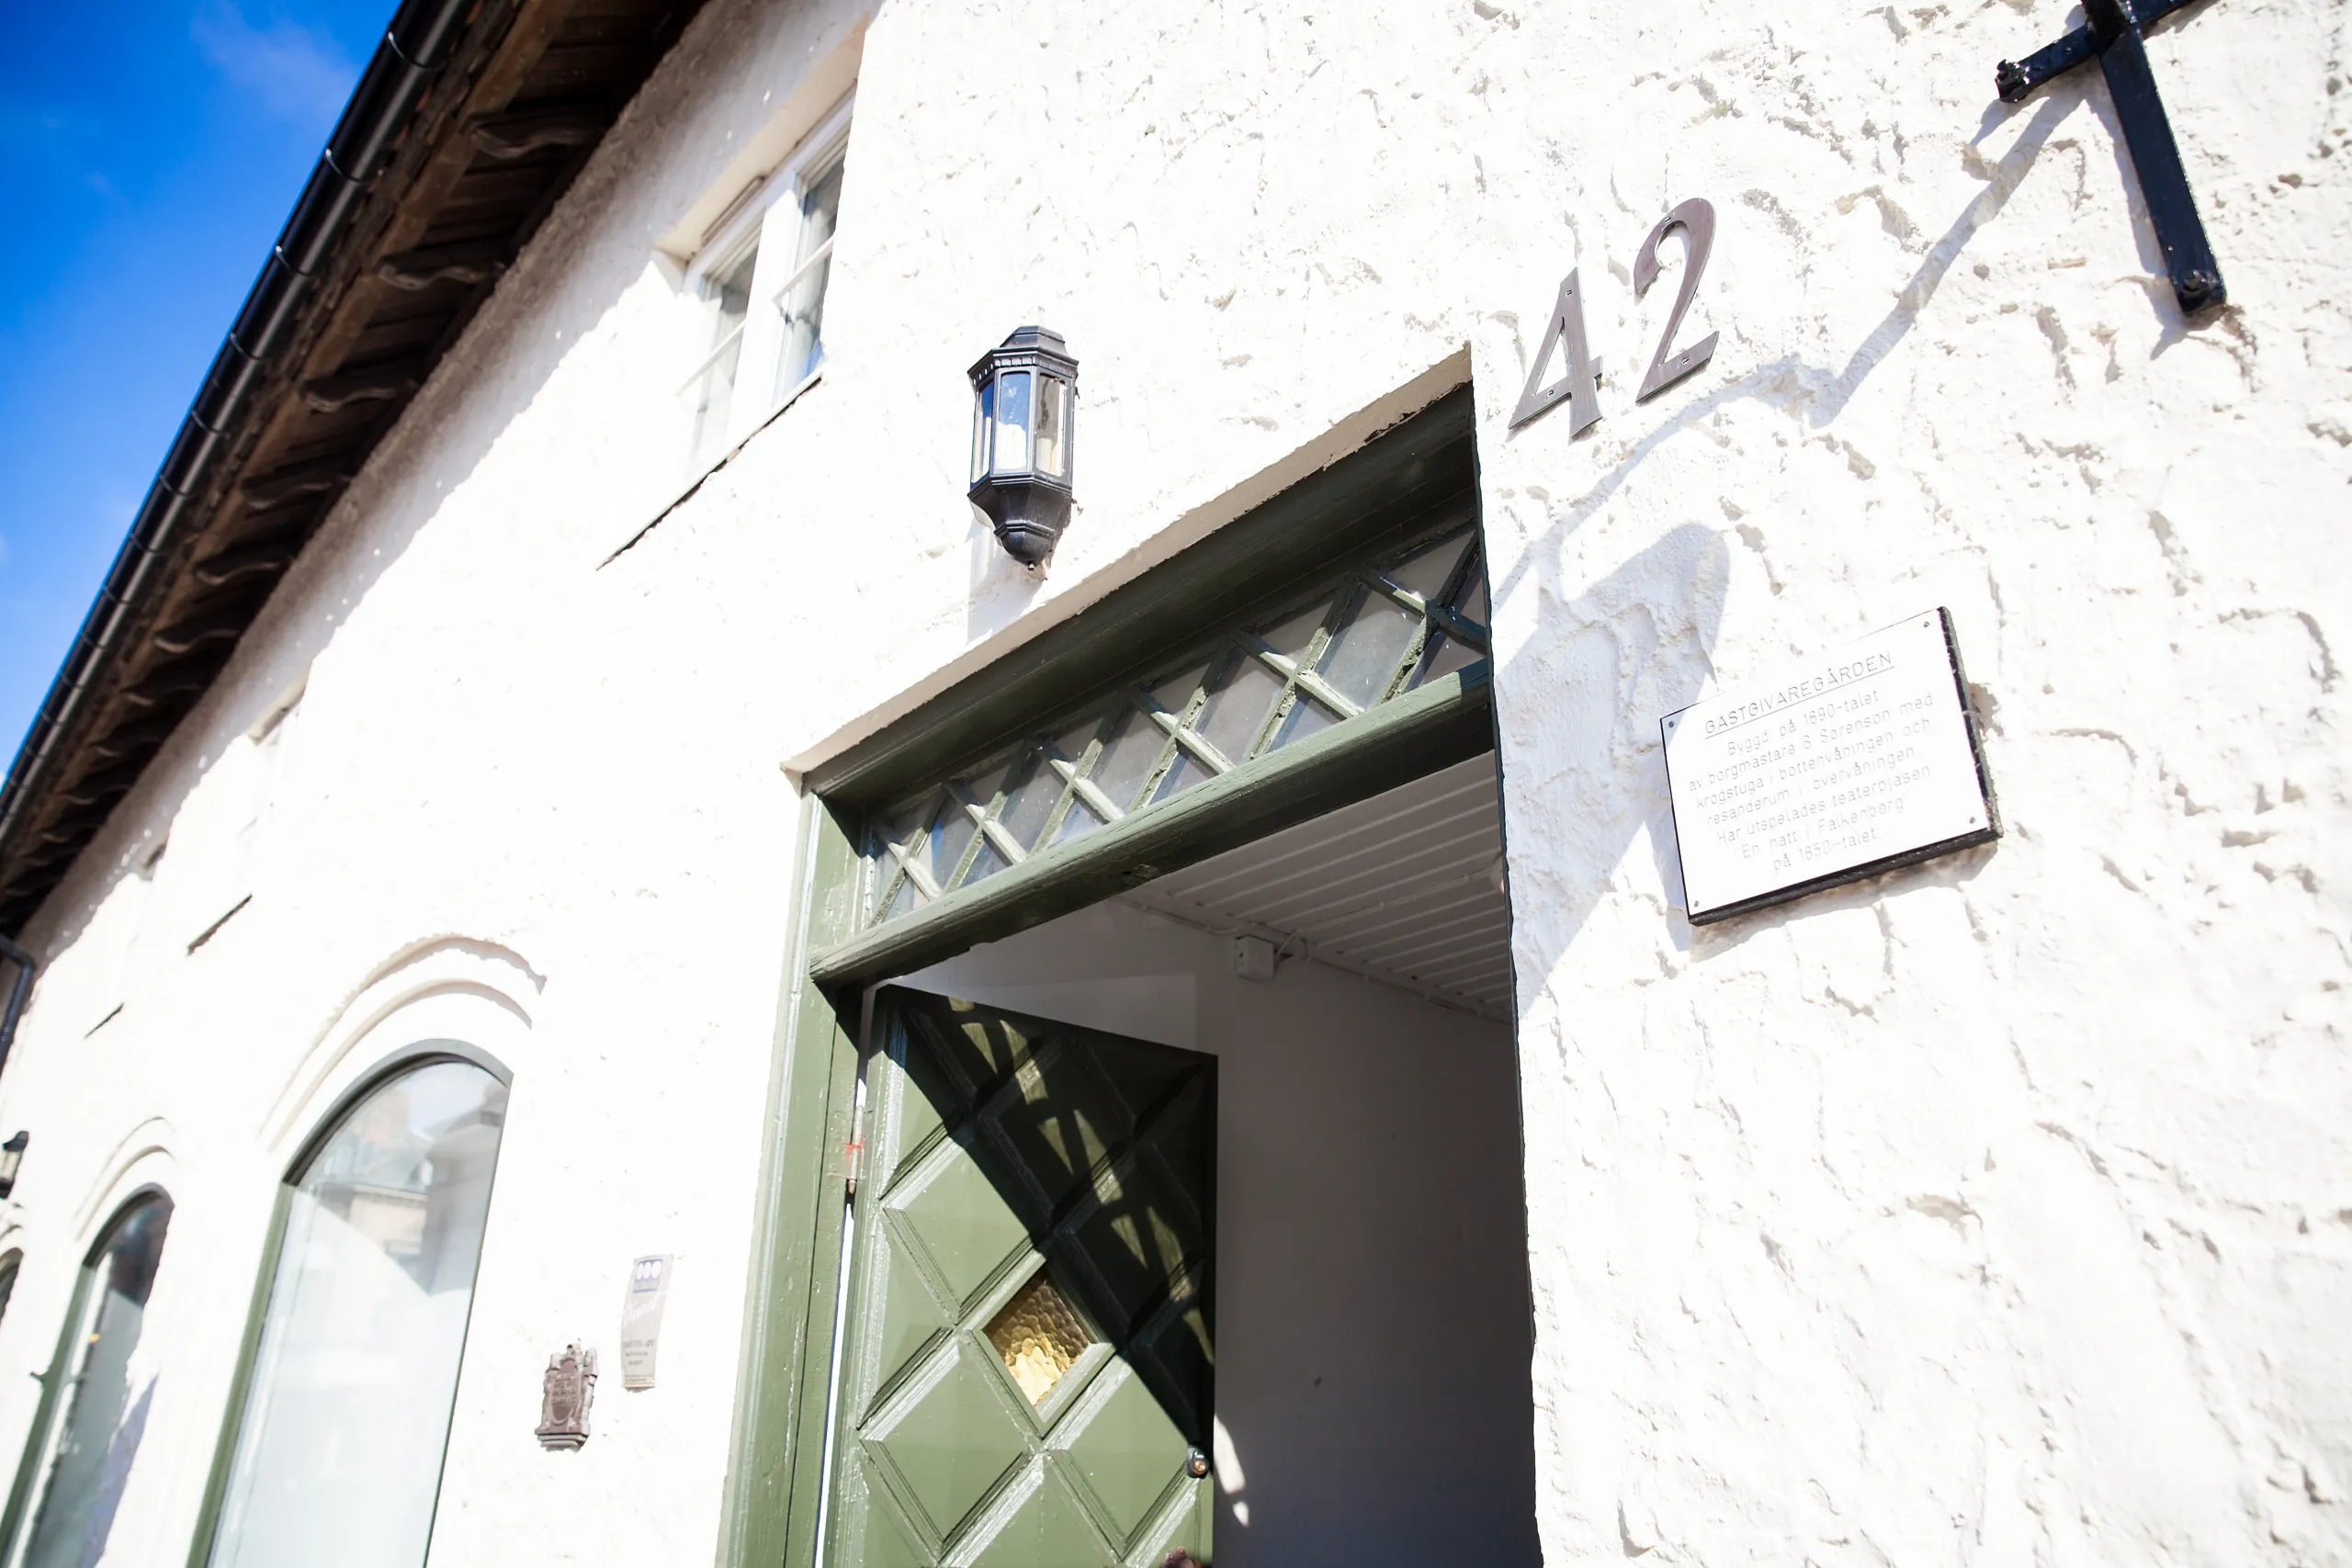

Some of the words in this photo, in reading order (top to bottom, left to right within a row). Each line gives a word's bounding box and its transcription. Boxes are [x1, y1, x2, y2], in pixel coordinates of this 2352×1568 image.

[1509, 197, 1719, 436] 42
[1705, 652, 1891, 734] GÄSTGIVAREGÅRDEN
[1727, 728, 1769, 756] Byggd
[1779, 717, 1796, 739] på
[1804, 689, 1879, 726] 1690-talet
[1689, 778, 1702, 792] av
[1803, 734, 1812, 750] S
[1898, 691, 1933, 715] med
[1696, 777, 1764, 808] krogstuga
[1903, 716, 1930, 737] och
[1707, 789, 1790, 825] resanderum
[1747, 800, 1826, 835] utspelades
[1769, 830, 1797, 848] natt
[1772, 852, 1792, 874] på
[1798, 828, 1876, 861] 1850-talet
